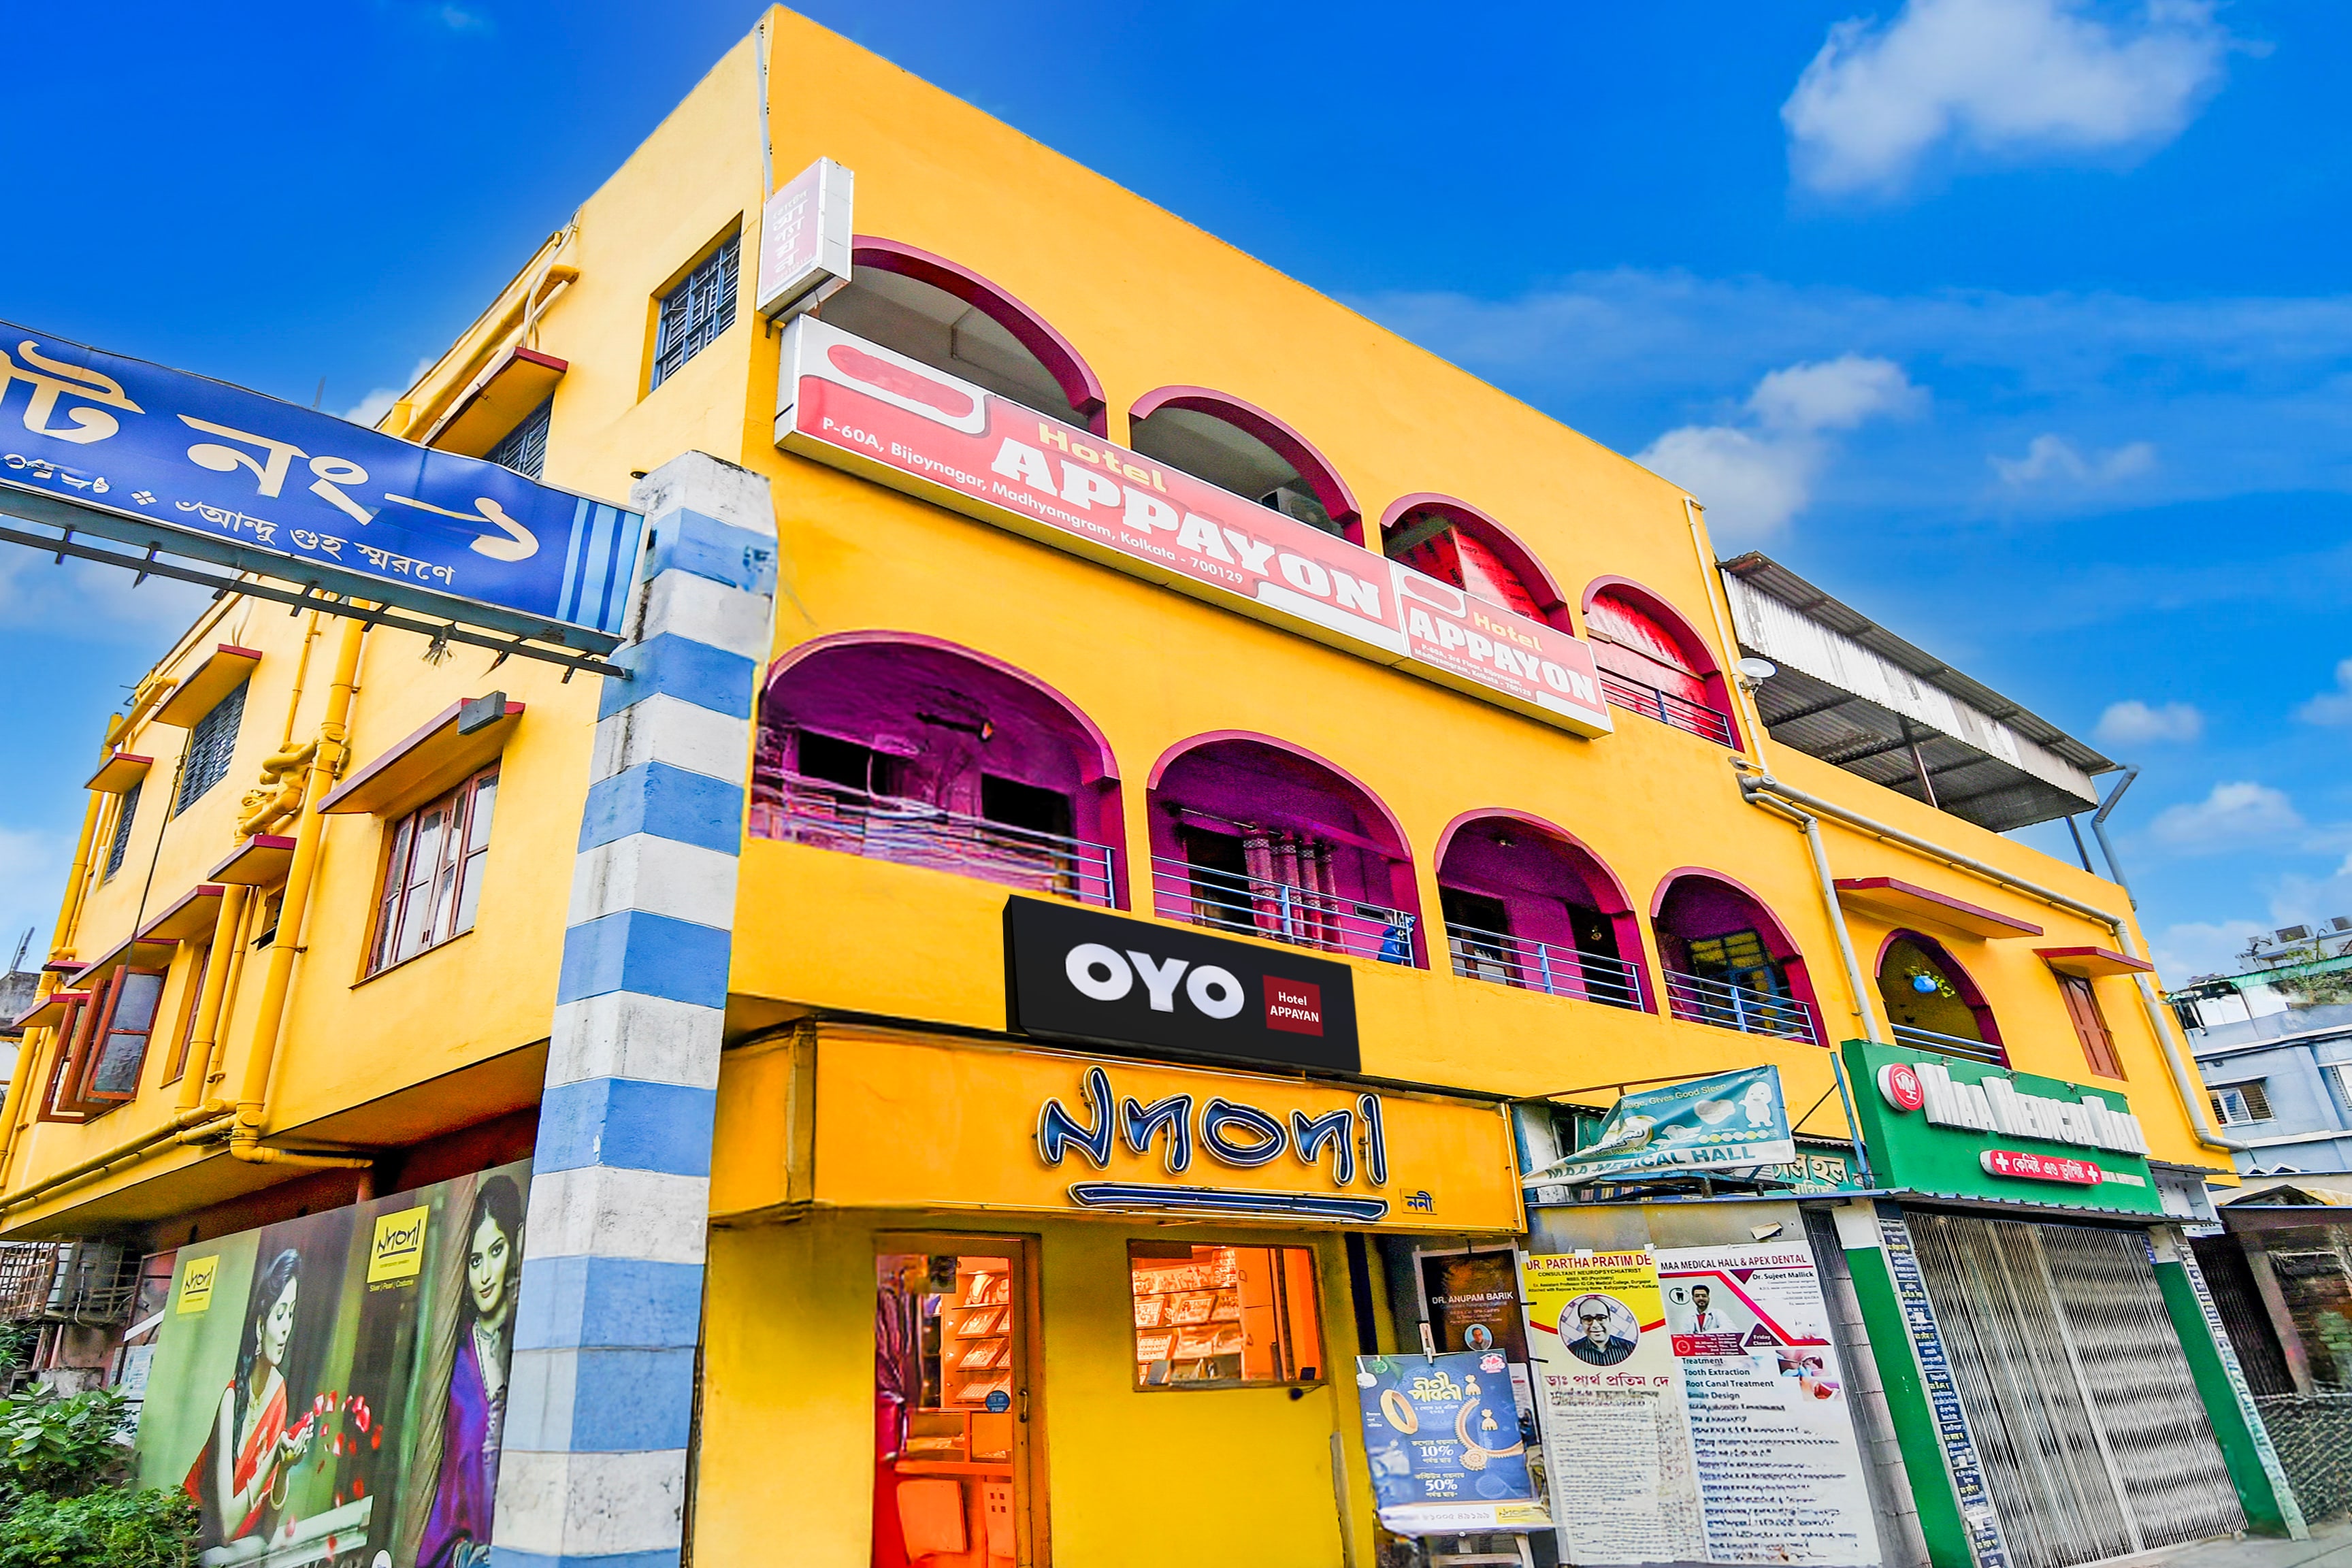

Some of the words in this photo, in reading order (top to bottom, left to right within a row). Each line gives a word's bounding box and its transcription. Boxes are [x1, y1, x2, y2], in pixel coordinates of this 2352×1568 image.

[1039, 422, 1167, 493] Hotel
[823, 417, 885, 453] P-60A,
[891, 442, 988, 491] Bijoynagar,
[992, 480, 1117, 541] Madhyamgram,
[1120, 531, 1176, 561] Kolkata
[1190, 557, 1243, 585] 700129
[991, 438, 1379, 620] APPAYON
[1473, 612, 1542, 651] Hotel
[1409, 606, 1597, 705] APPAYON
[1065, 943, 1245, 1019] OYO
[1278, 991, 1307, 1007] Hotel
[1270, 1004, 1320, 1022] APPAYAN
[1649, 1094, 1674, 1105] Gives
[1676, 1090, 1699, 1099] Good
[1701, 1083, 1726, 1093] Sleep
[1913, 1062, 1999, 1132] MAA
[1981, 1077, 2101, 1145] MEDICAL
[2081, 1096, 2151, 1155] HALL
[1545, 1165, 1587, 1179] MAA
[1592, 1152, 1686, 1173] MEDICAL
[1690, 1146, 1756, 1162] HALL
[1810, 1155, 1849, 1186] হল
[1405, 1190, 1433, 1212] ননী
[1526, 1259, 1544, 1270] DR.
[1546, 1257, 1590, 1269] PARTHA
[1592, 1255, 1633, 1267] PRATIM
[1637, 1254, 1652, 1265] DE
[1680, 1260, 1716, 1269] MEDICAL
[1718, 1259, 1740, 1267] HALL
[1740, 1258, 1747, 1266] &
[1748, 1256, 1771, 1265] APEX
[1773, 1254, 1807, 1264] DENTAL
[1448, 1294, 1484, 1303] ANUPAM
[1486, 1292, 1514, 1300] BARIK
[1606, 1371, 1646, 1386] প্রতিম
[1653, 1376, 1669, 1387] দে
[1711, 1392, 1740, 1401] Design
[1420, 1445, 1454, 1457] 10%
[1425, 1479, 1458, 1491] 50%
